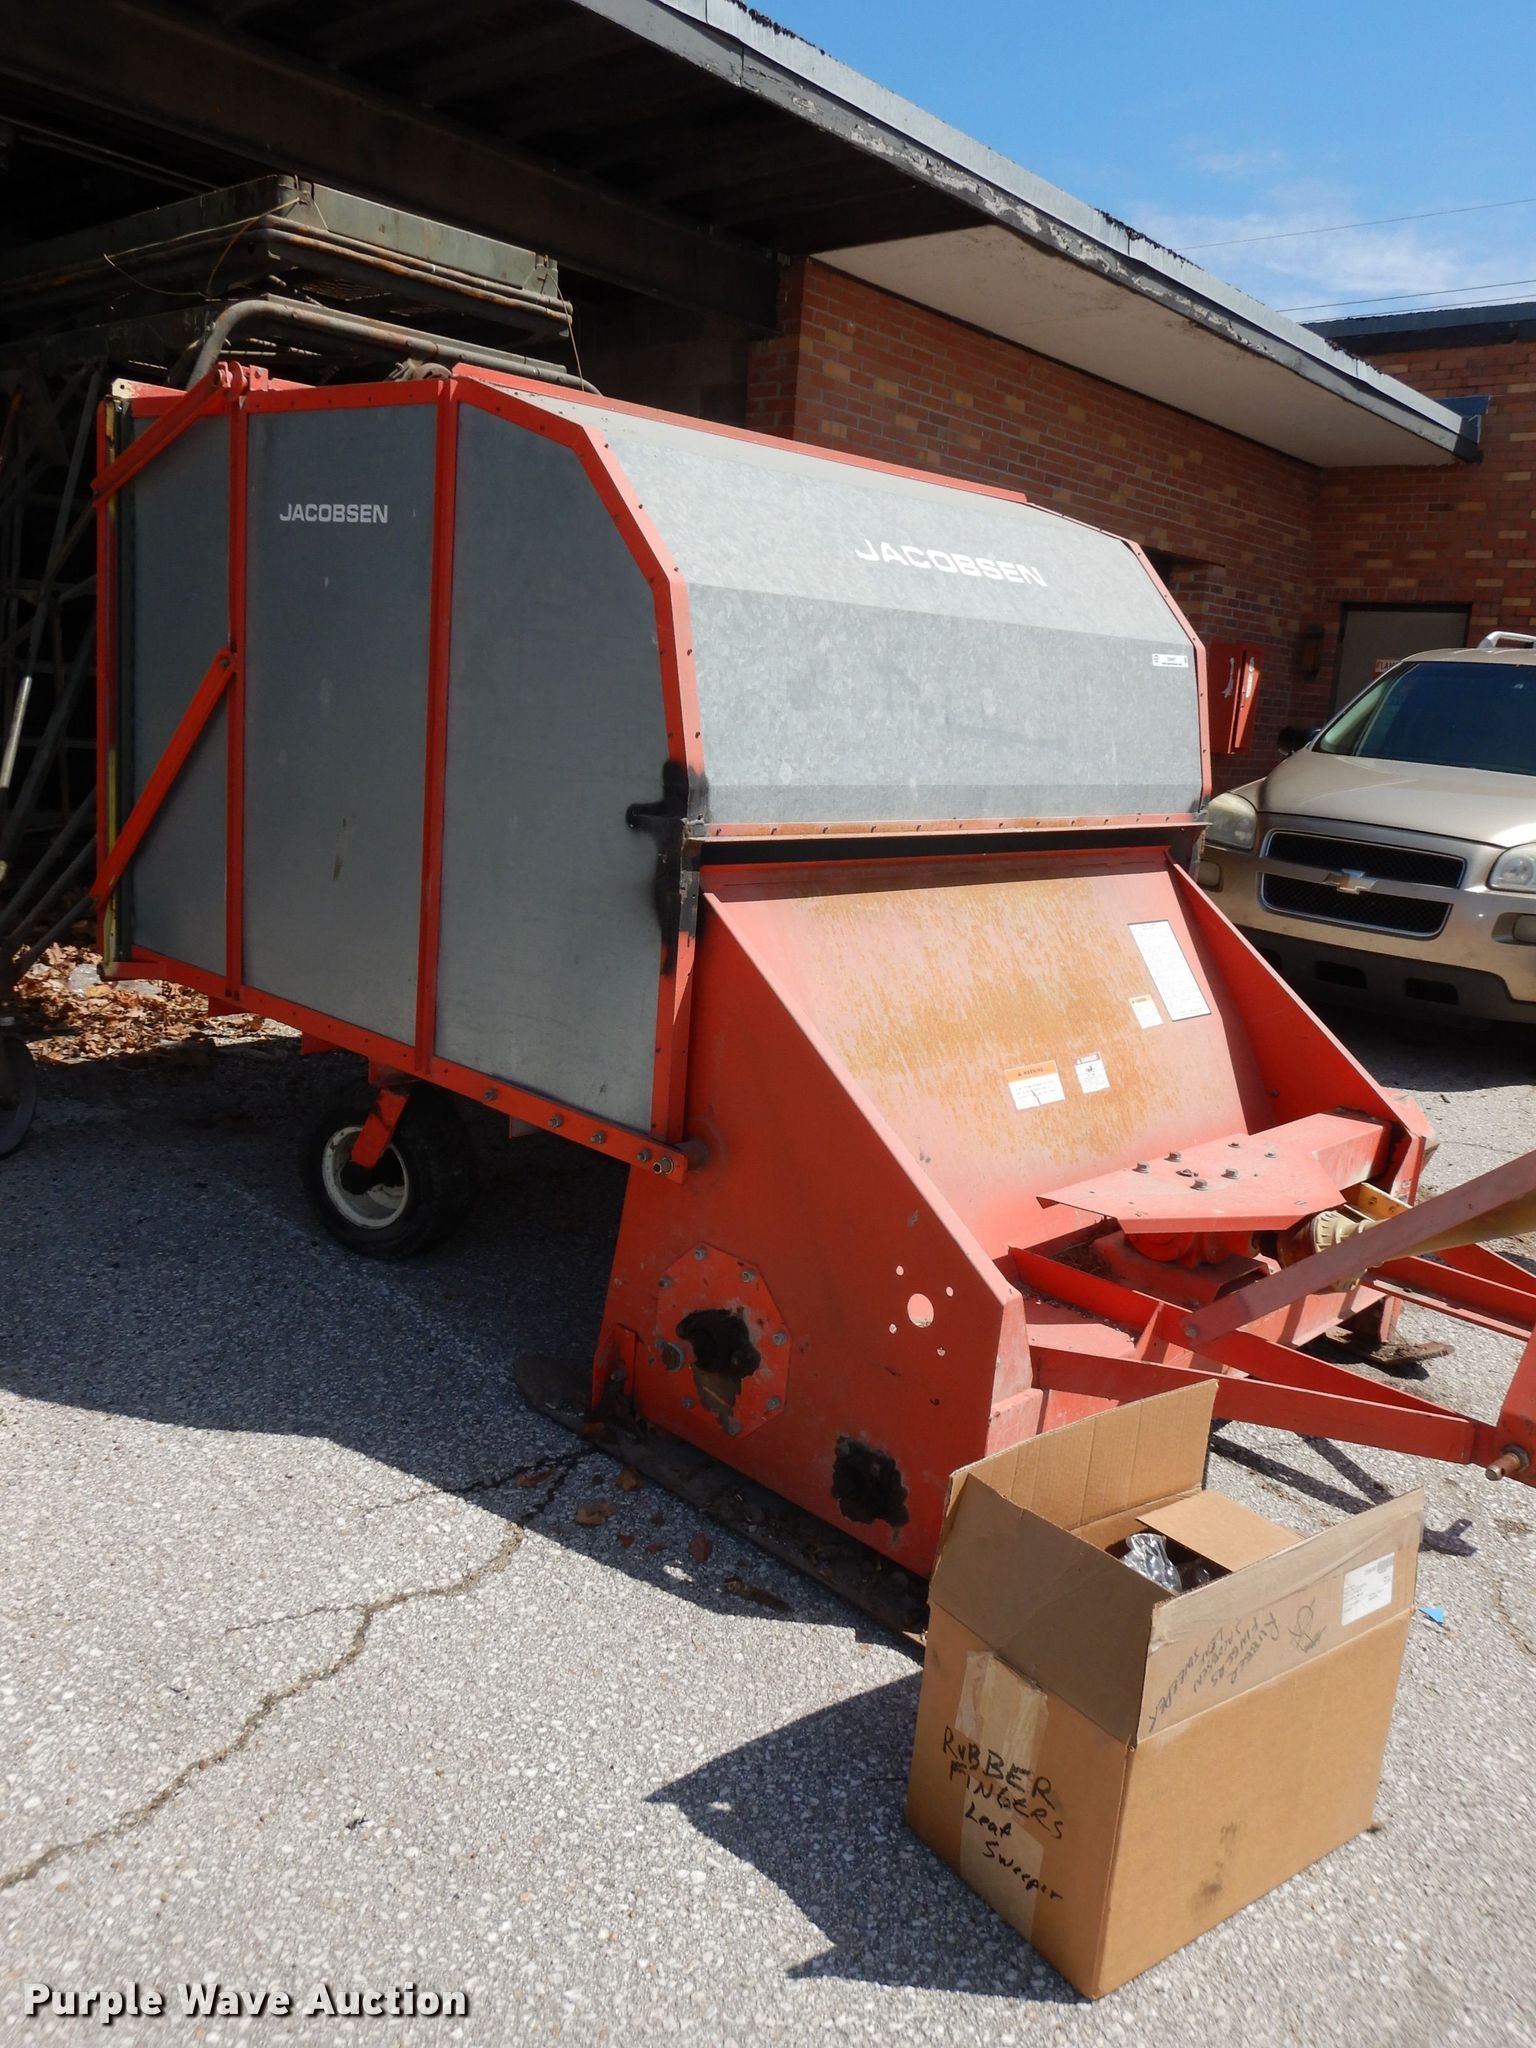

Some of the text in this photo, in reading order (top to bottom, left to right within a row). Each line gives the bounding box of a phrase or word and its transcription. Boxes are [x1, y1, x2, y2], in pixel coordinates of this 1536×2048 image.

[279, 503, 388, 523] JACOBSEN
[855, 538, 1048, 587] JACOBSEN
[949, 1760, 1063, 1839] FINGERS
